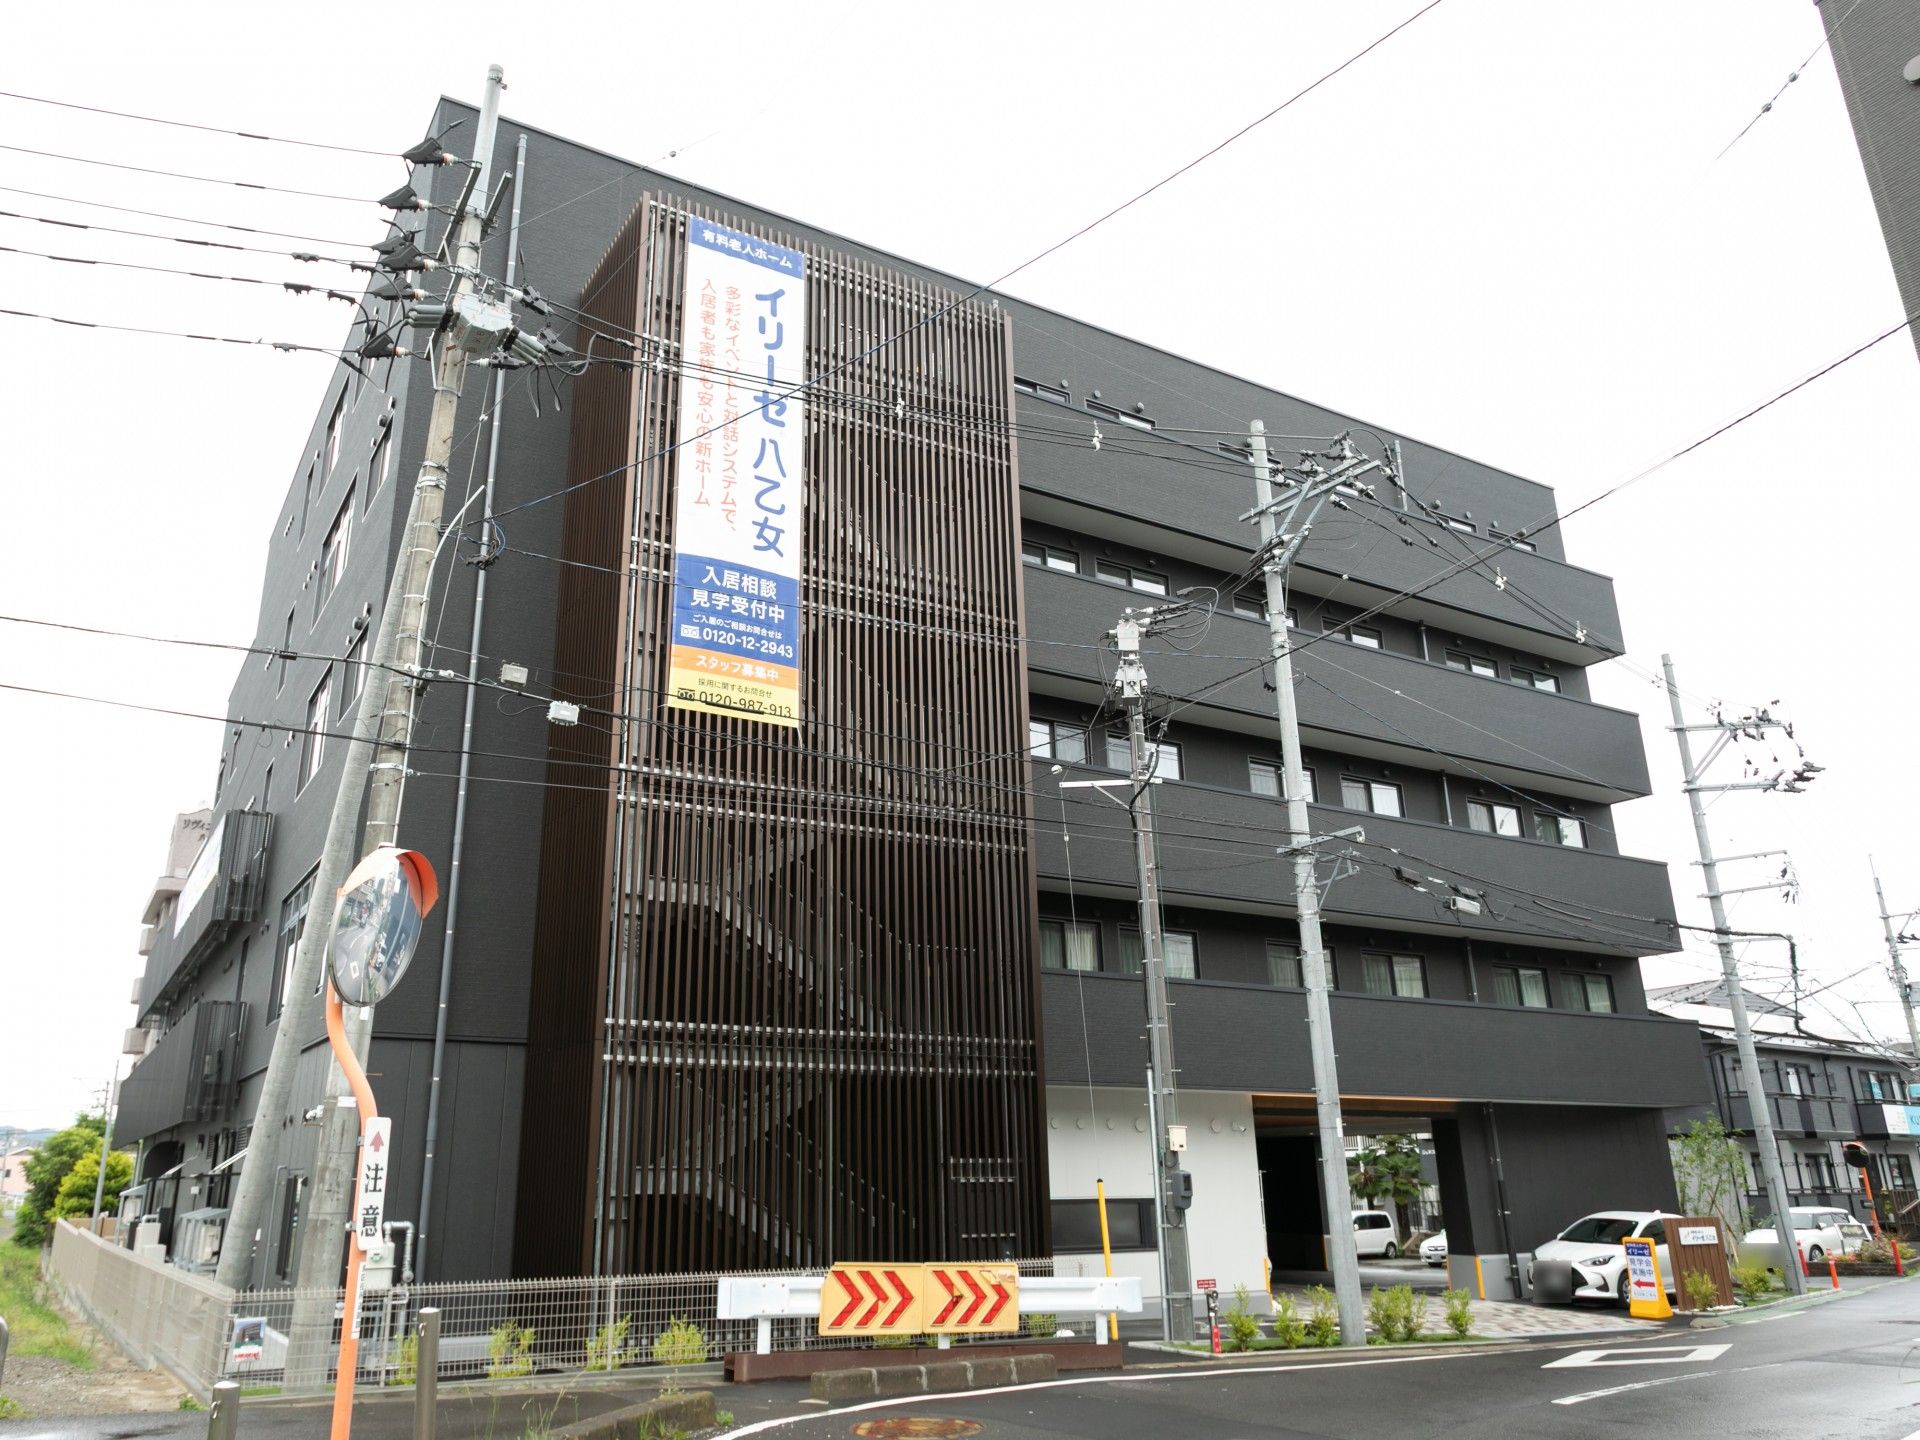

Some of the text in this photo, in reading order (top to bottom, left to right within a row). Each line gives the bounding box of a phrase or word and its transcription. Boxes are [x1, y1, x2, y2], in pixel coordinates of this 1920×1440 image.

[702, 229, 793, 269] 有料老人ホーム
[702, 565, 777, 600] 入居相談
[691, 588, 785, 624] 見学受付中
[702, 627, 794, 659] 0120-12-2943
[695, 655, 779, 681] スタッフ募集中
[697, 678, 774, 699] 採用に関するお問合せ
[698, 691, 792, 719] 0120-987-913
[361, 1162, 385, 1238] 注意
[1629, 1257, 1652, 1267] 見学会
[1631, 1267, 1654, 1277] 実施中
